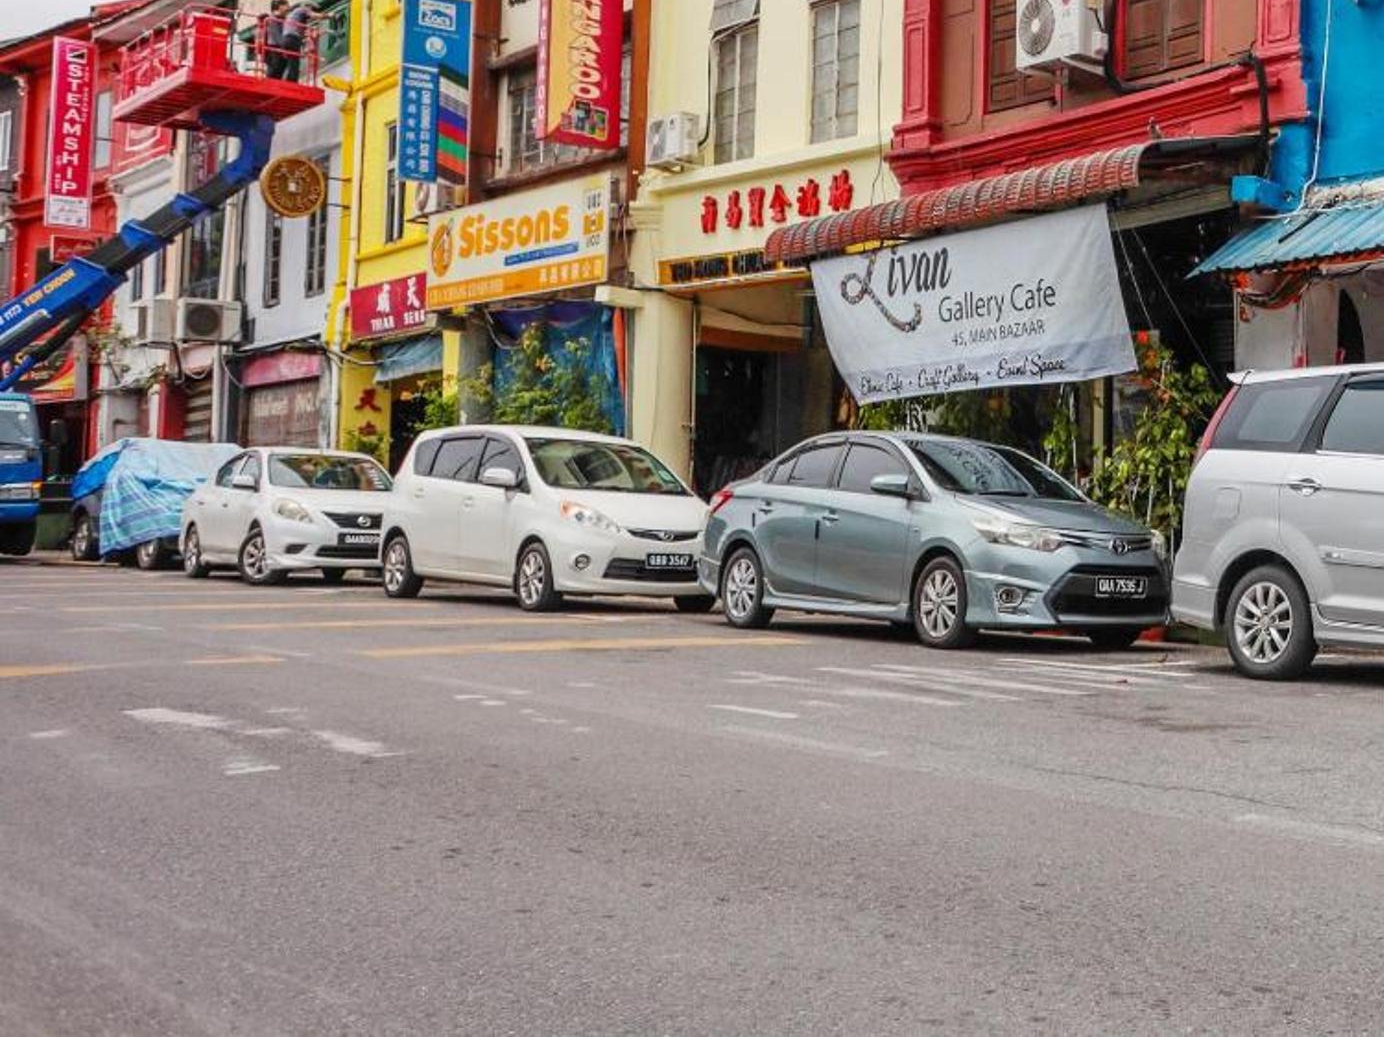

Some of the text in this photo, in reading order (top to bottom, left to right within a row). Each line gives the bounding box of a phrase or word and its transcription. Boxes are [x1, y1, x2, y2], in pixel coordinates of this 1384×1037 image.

[61, 64, 83, 194] STEAMSHIP
[458, 205, 570, 259] Sissons
[841, 247, 951, 333] Livan
[938, 278, 1057, 323] Gallery Cafe
[969, 326, 998, 344] MAIN
[999, 319, 1046, 339] BAZAAR
